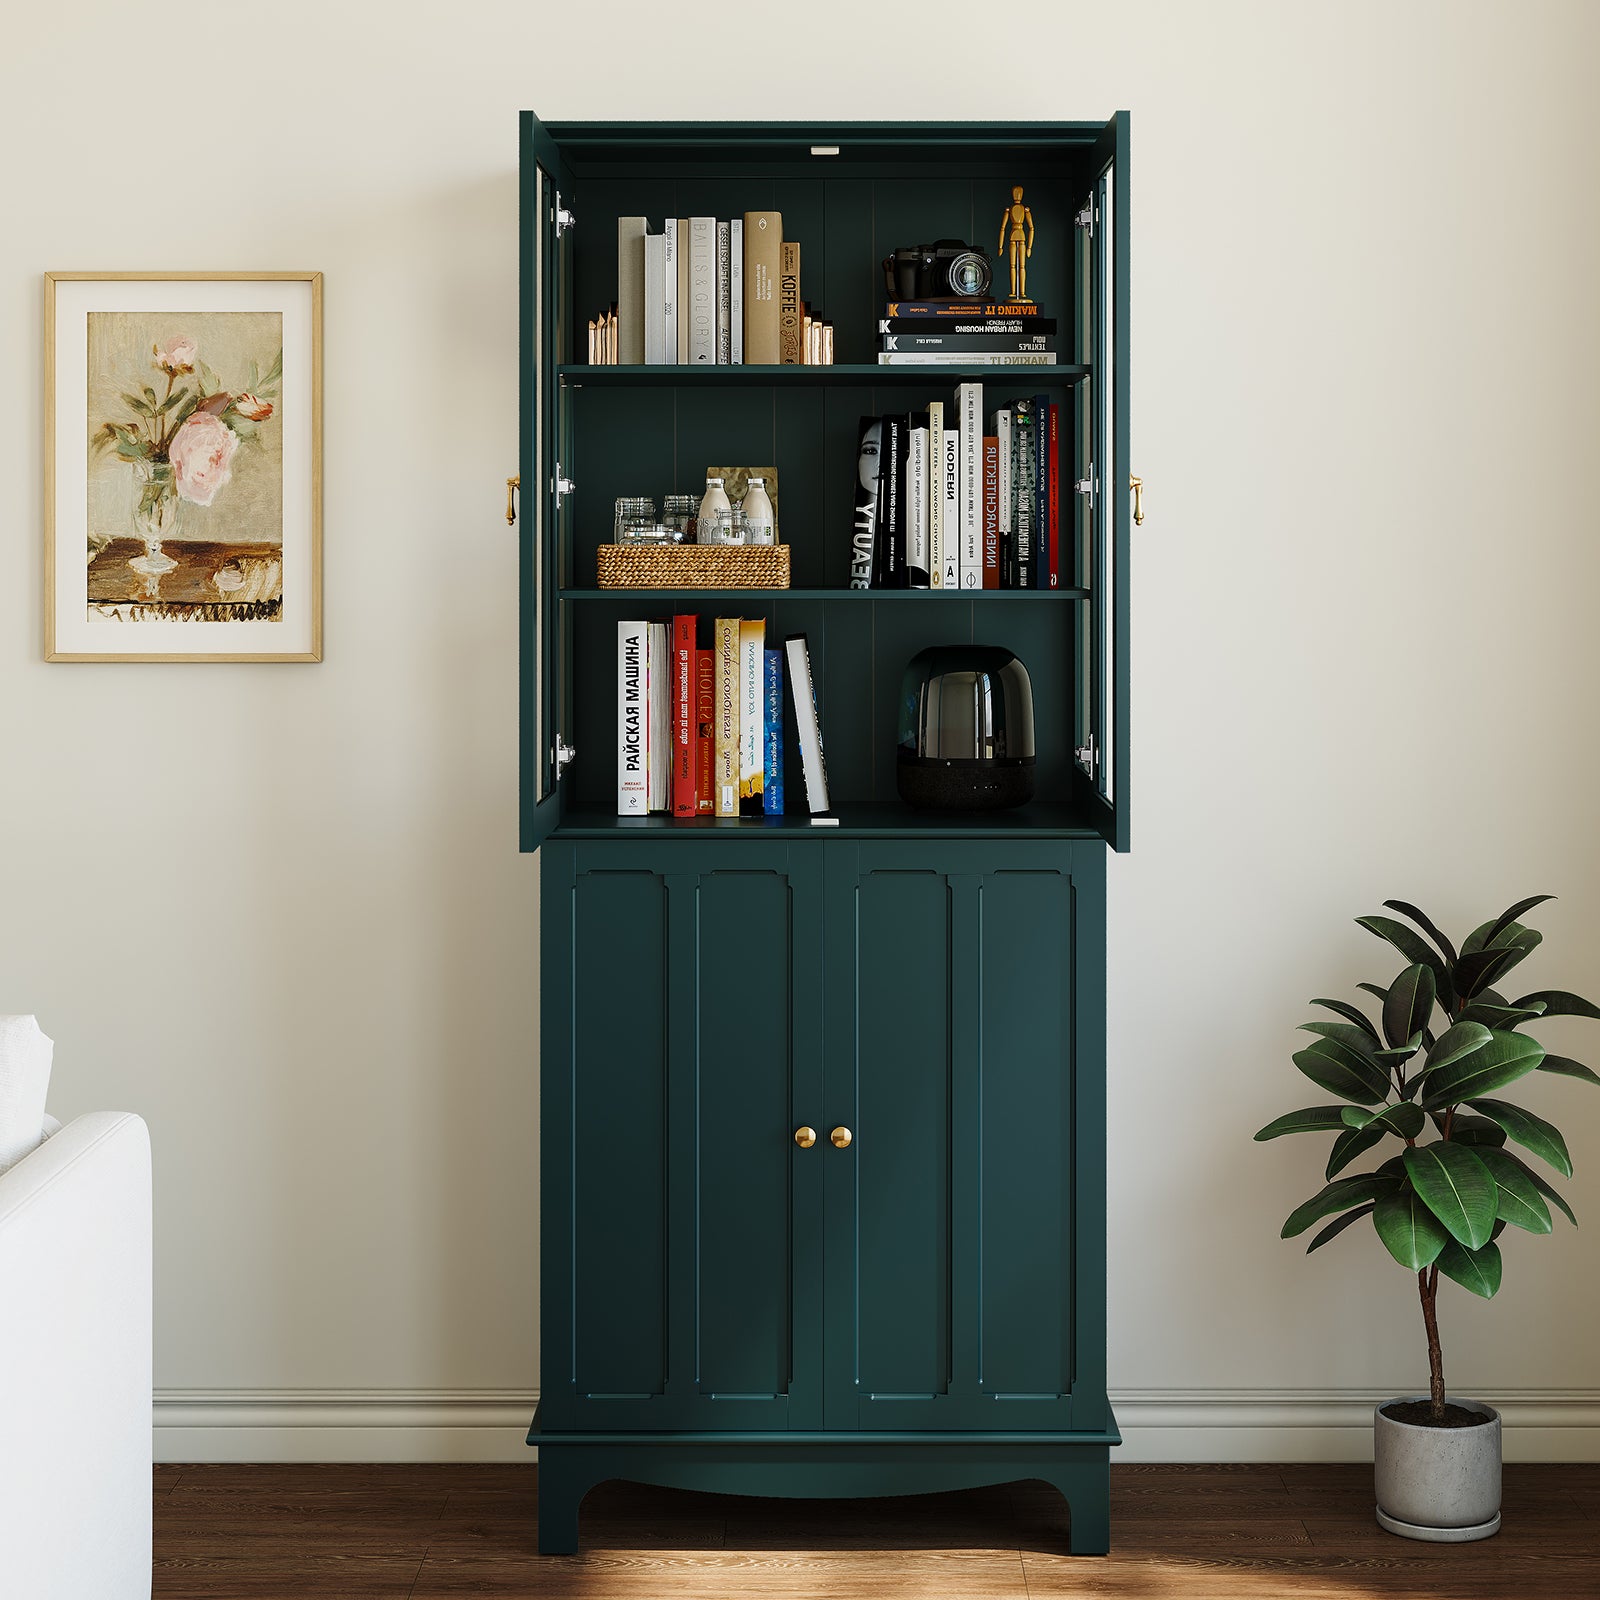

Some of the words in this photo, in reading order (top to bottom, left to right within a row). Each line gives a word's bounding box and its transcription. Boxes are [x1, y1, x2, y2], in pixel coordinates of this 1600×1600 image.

[720, 227, 728, 278] GESELLSCHAFT
[782, 275, 796, 313] KOFFIE
[985, 305, 996, 315] IT
[998, 305, 1037, 315] MAKING
[695, 293, 709, 348] GLORY
[1018, 343, 1046, 351] TEXTILES
[947, 566, 954, 578] A
[626, 636, 639, 702] МАШИНА
[622, 706, 639, 771] РАЙСКАЯ
